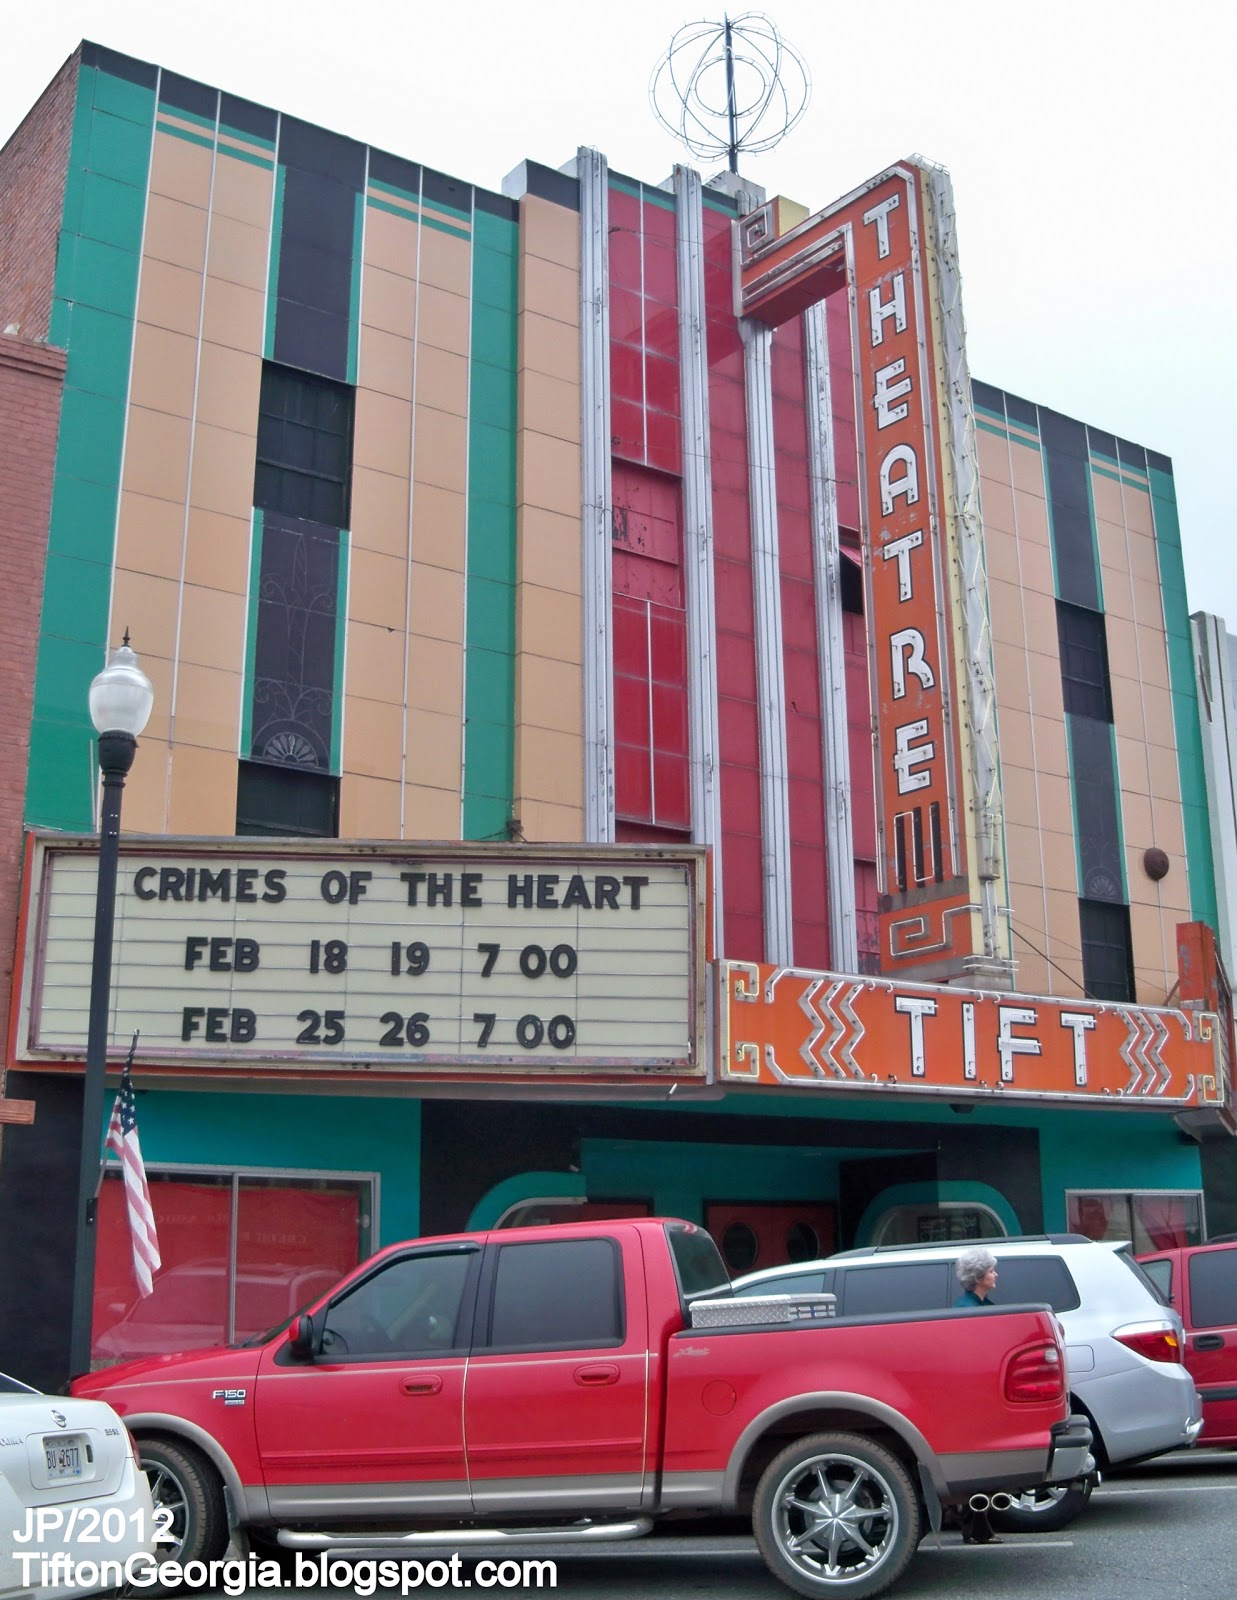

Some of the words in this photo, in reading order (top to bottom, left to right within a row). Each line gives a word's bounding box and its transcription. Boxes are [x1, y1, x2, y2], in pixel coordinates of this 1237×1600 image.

[863, 193, 936, 796] THEATRE
[133, 866, 286, 904] CRIMES
[321, 870, 373, 905] OF
[400, 871, 483, 908] THE
[508, 874, 650, 911] HEART
[185, 936, 260, 973] FEB
[310, 939, 349, 975] 18
[391, 941, 430, 977] 19
[477, 943, 501, 978] 7
[520, 944, 578, 980] 00
[182, 1006, 257, 1044] FEB
[296, 1009, 346, 1046] 25
[379, 1011, 430, 1048] 26
[473, 1013, 496, 1048] 7
[517, 1014, 576, 1050] 00
[894, 994, 1097, 1087] TIFT
